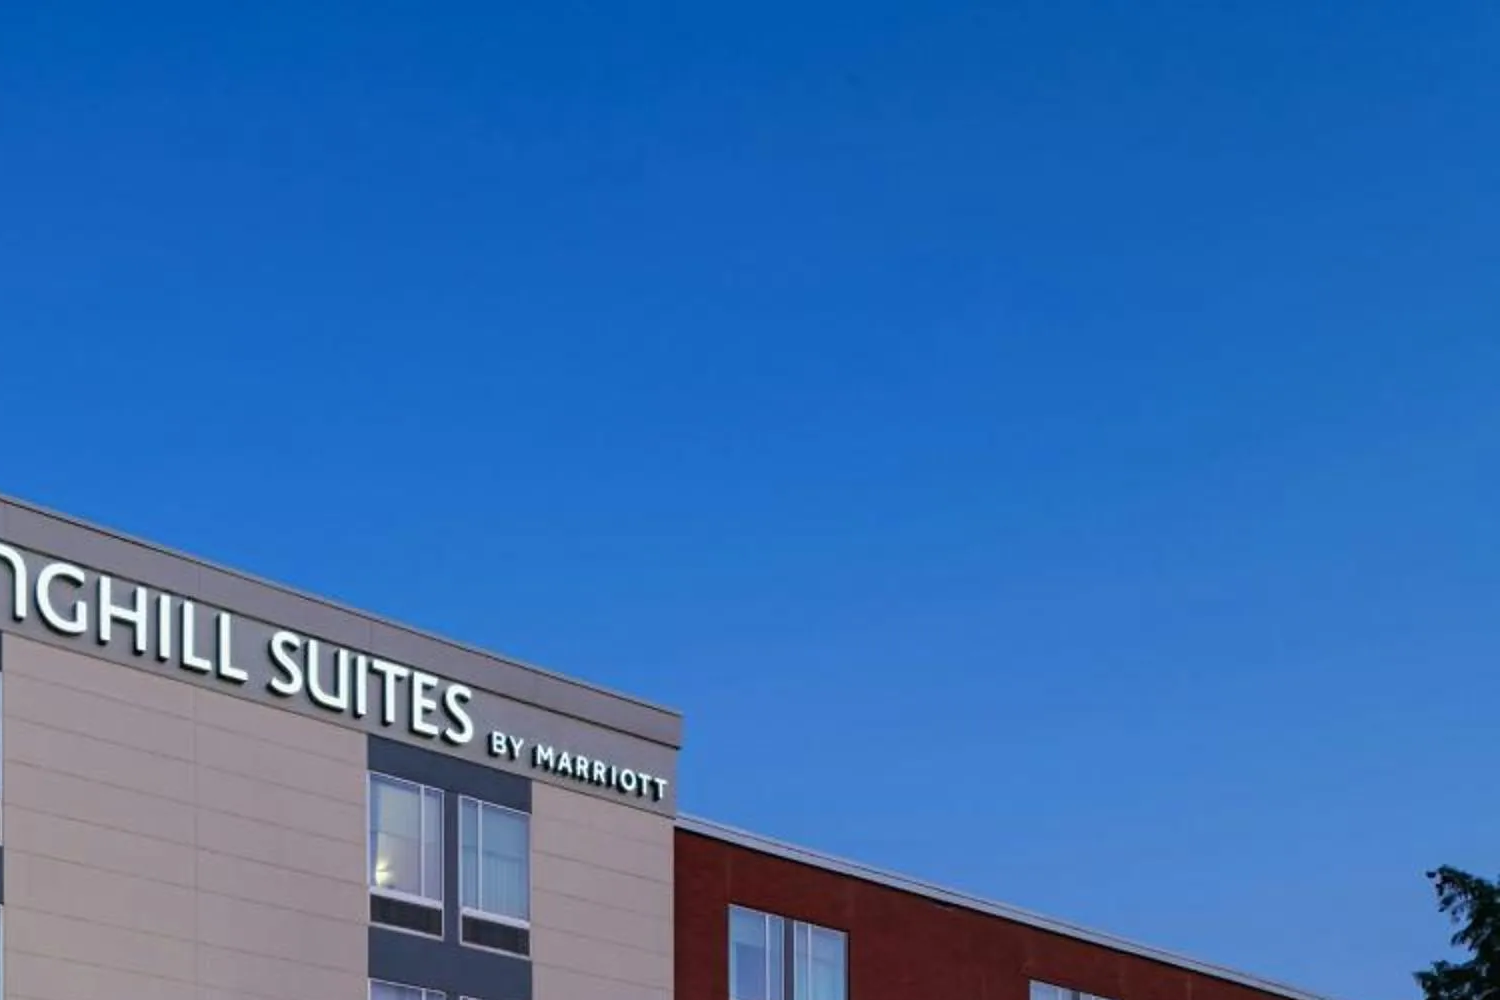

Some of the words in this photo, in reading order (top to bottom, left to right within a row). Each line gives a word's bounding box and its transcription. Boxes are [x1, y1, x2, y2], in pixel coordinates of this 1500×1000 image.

[267, 629, 475, 744] SUITES
[488, 730, 525, 761] BY
[533, 743, 668, 801] MARRIOTT
